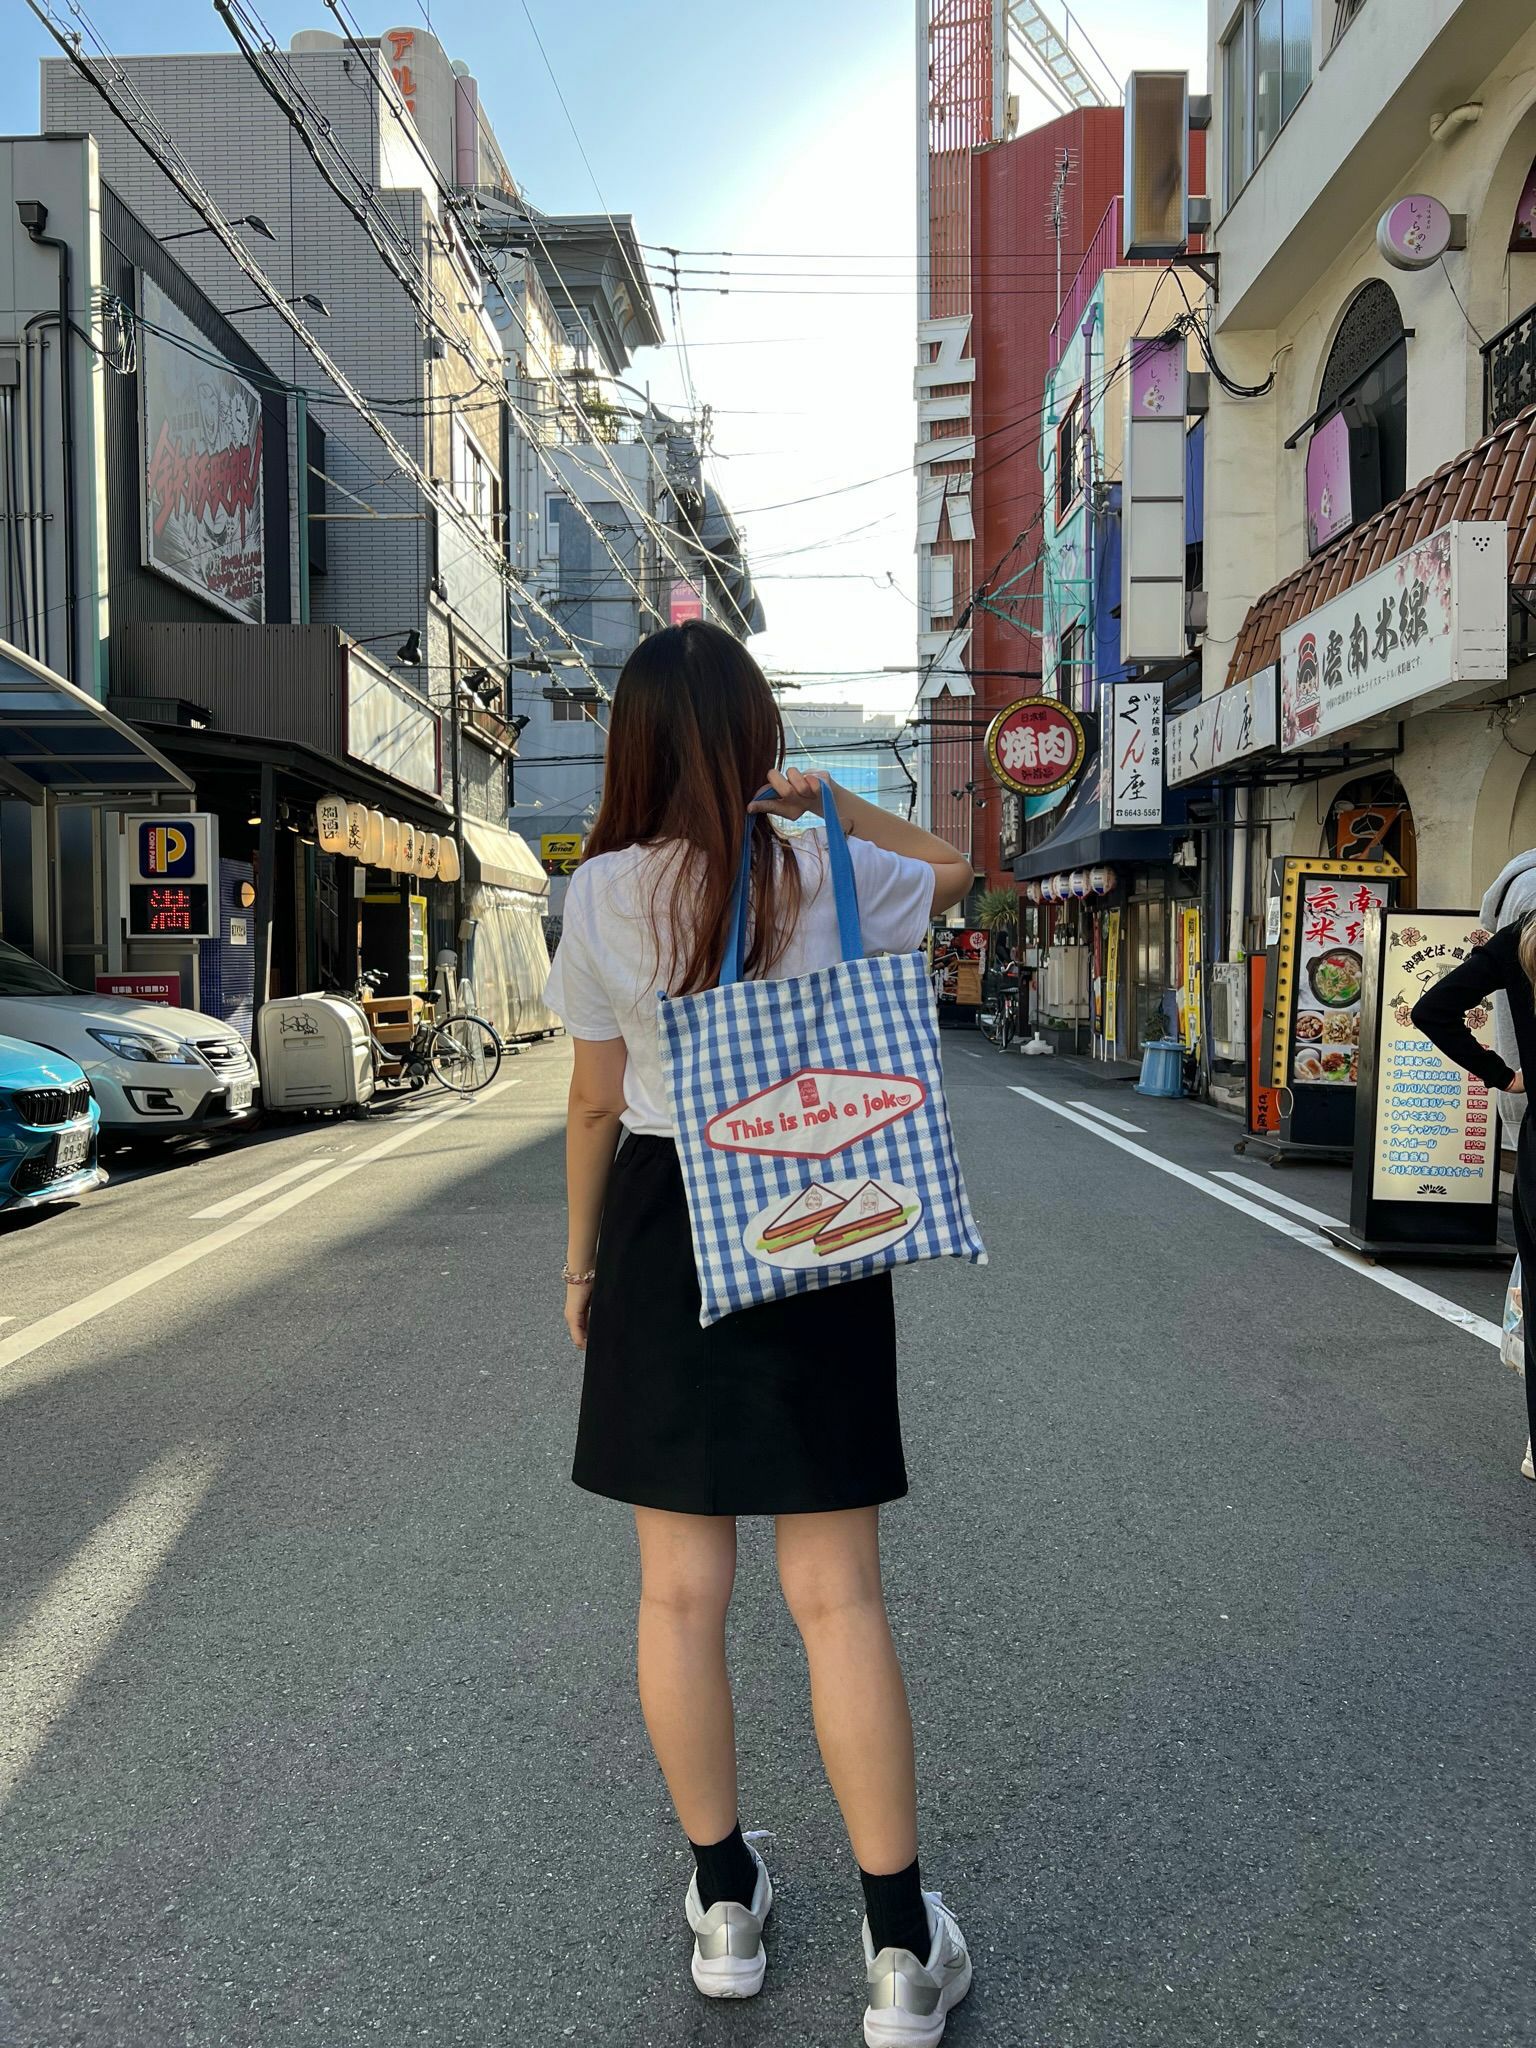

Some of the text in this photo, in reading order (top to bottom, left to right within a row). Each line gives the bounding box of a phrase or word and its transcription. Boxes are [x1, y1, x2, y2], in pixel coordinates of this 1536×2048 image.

[1323, 578, 1428, 690] 雲南米線
[1000, 725, 1073, 769] 焼肉
[1124, 809, 1160, 817] 6643-5567
[150, 889, 190, 930] 満
[1306, 885, 1382, 913] 云南
[727, 1119, 775, 1141] This
[779, 1112, 798, 1132] is
[803, 1101, 838, 1126] not
[843, 1105, 858, 1117] a
[1390, 1137, 1437, 1149] ハイボール
